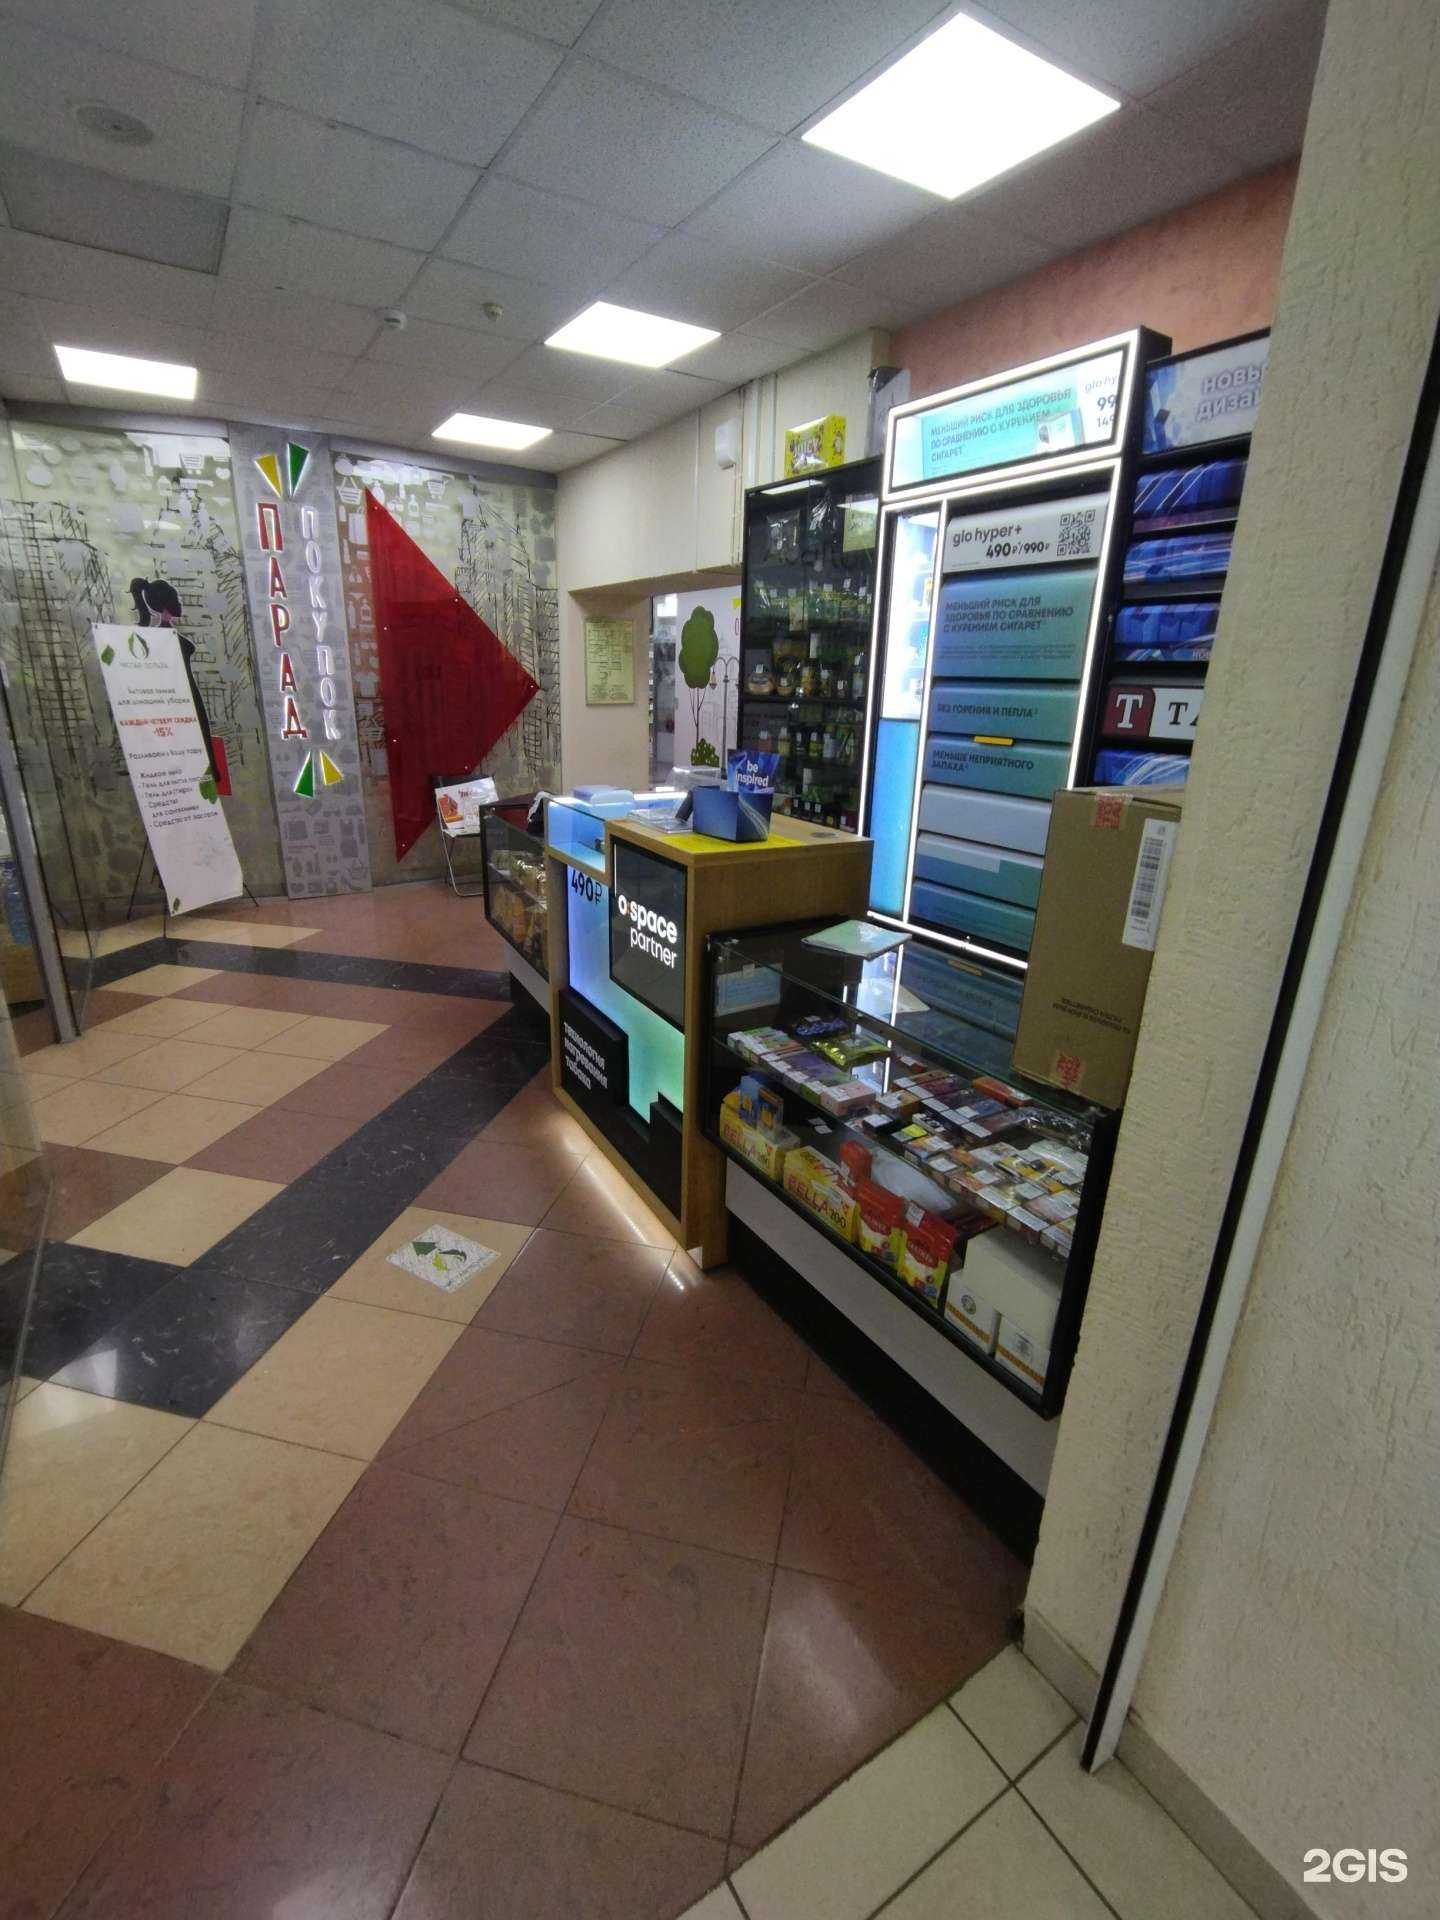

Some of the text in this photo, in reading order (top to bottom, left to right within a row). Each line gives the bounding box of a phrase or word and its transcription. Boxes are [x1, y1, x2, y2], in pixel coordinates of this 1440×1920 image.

[953, 524, 1022, 547] glo hyper+
[992, 609, 1007, 621] ПО
[1009, 606, 1074, 619] СРАВНЕНИЮ
[1020, 596, 1041, 608] ДЛЯ
[256, 502, 308, 739] ПАРАД
[301, 505, 341, 740] ПОКУПОК
[1115, 694, 1143, 729] T
[1168, 702, 1201, 727] T
[747, 760, 759, 773] be
[736, 772, 769, 788] inspired
[630, 927, 677, 969] partner
[788, 1172, 828, 1215] BELLA
